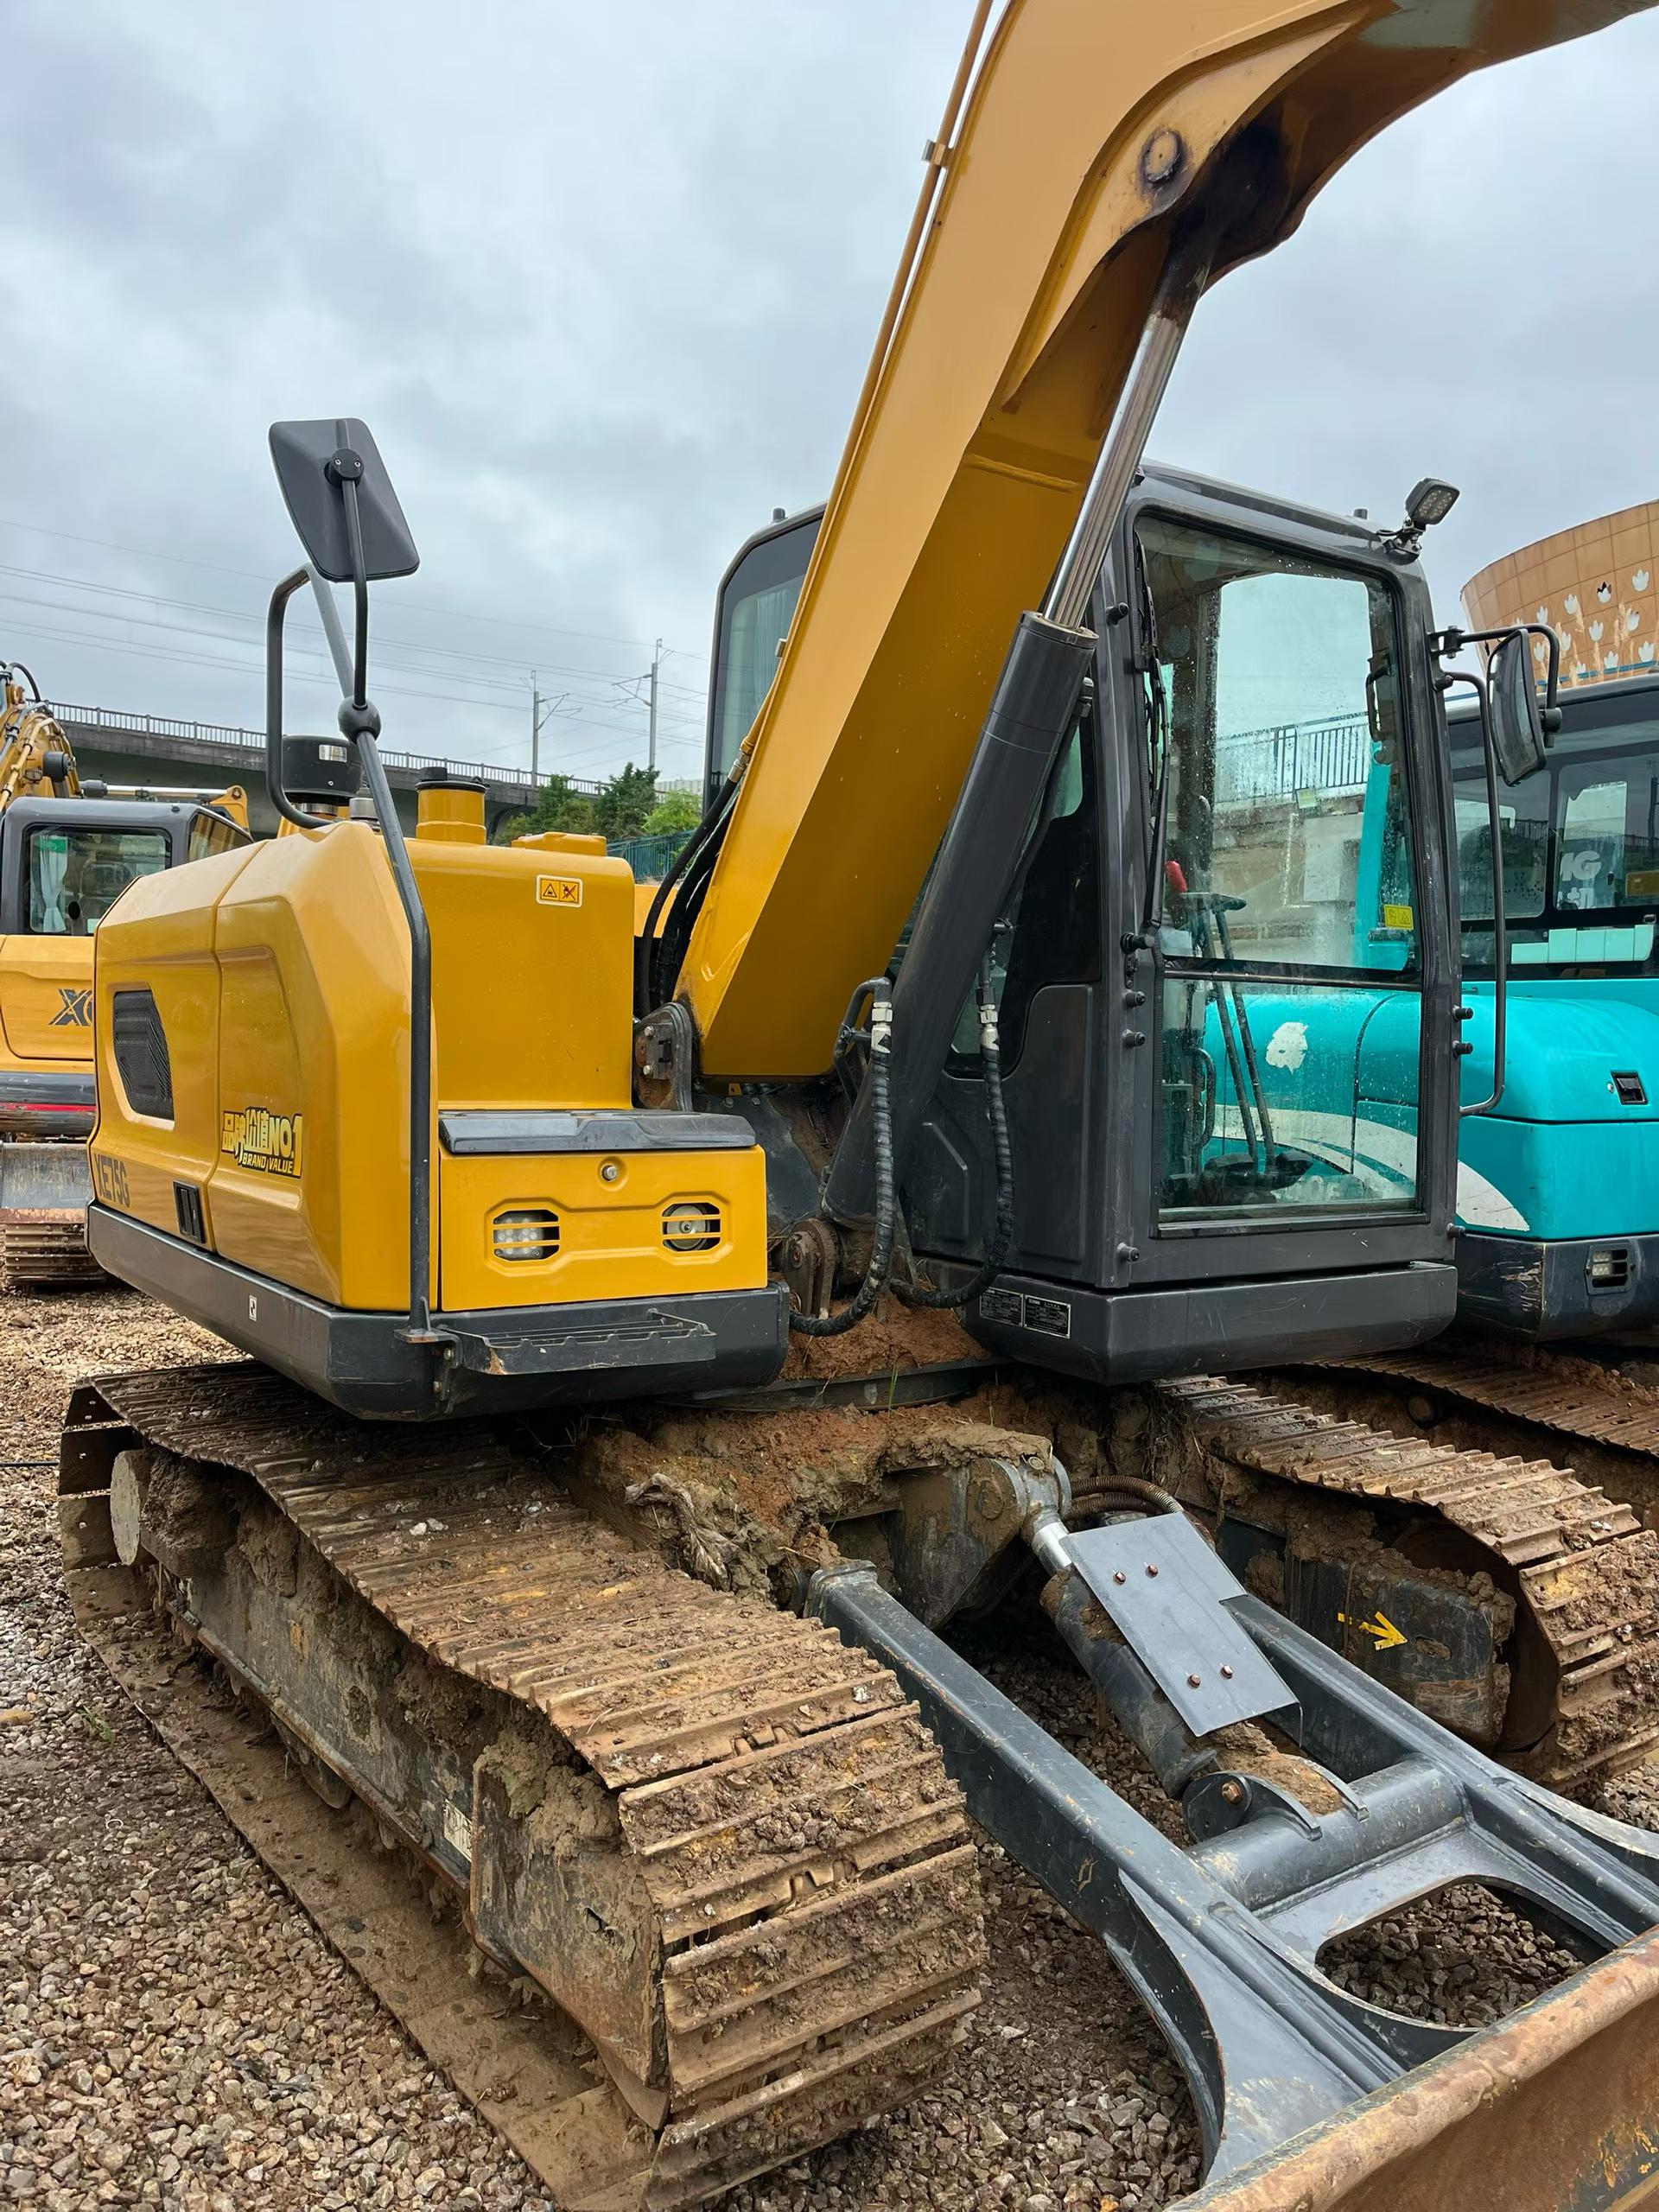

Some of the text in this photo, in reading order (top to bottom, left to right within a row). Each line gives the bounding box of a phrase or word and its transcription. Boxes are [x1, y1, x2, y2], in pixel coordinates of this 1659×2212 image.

[94, 1153, 130, 1208] XE75G
[242, 1152, 294, 1174] BRAND VALUE
